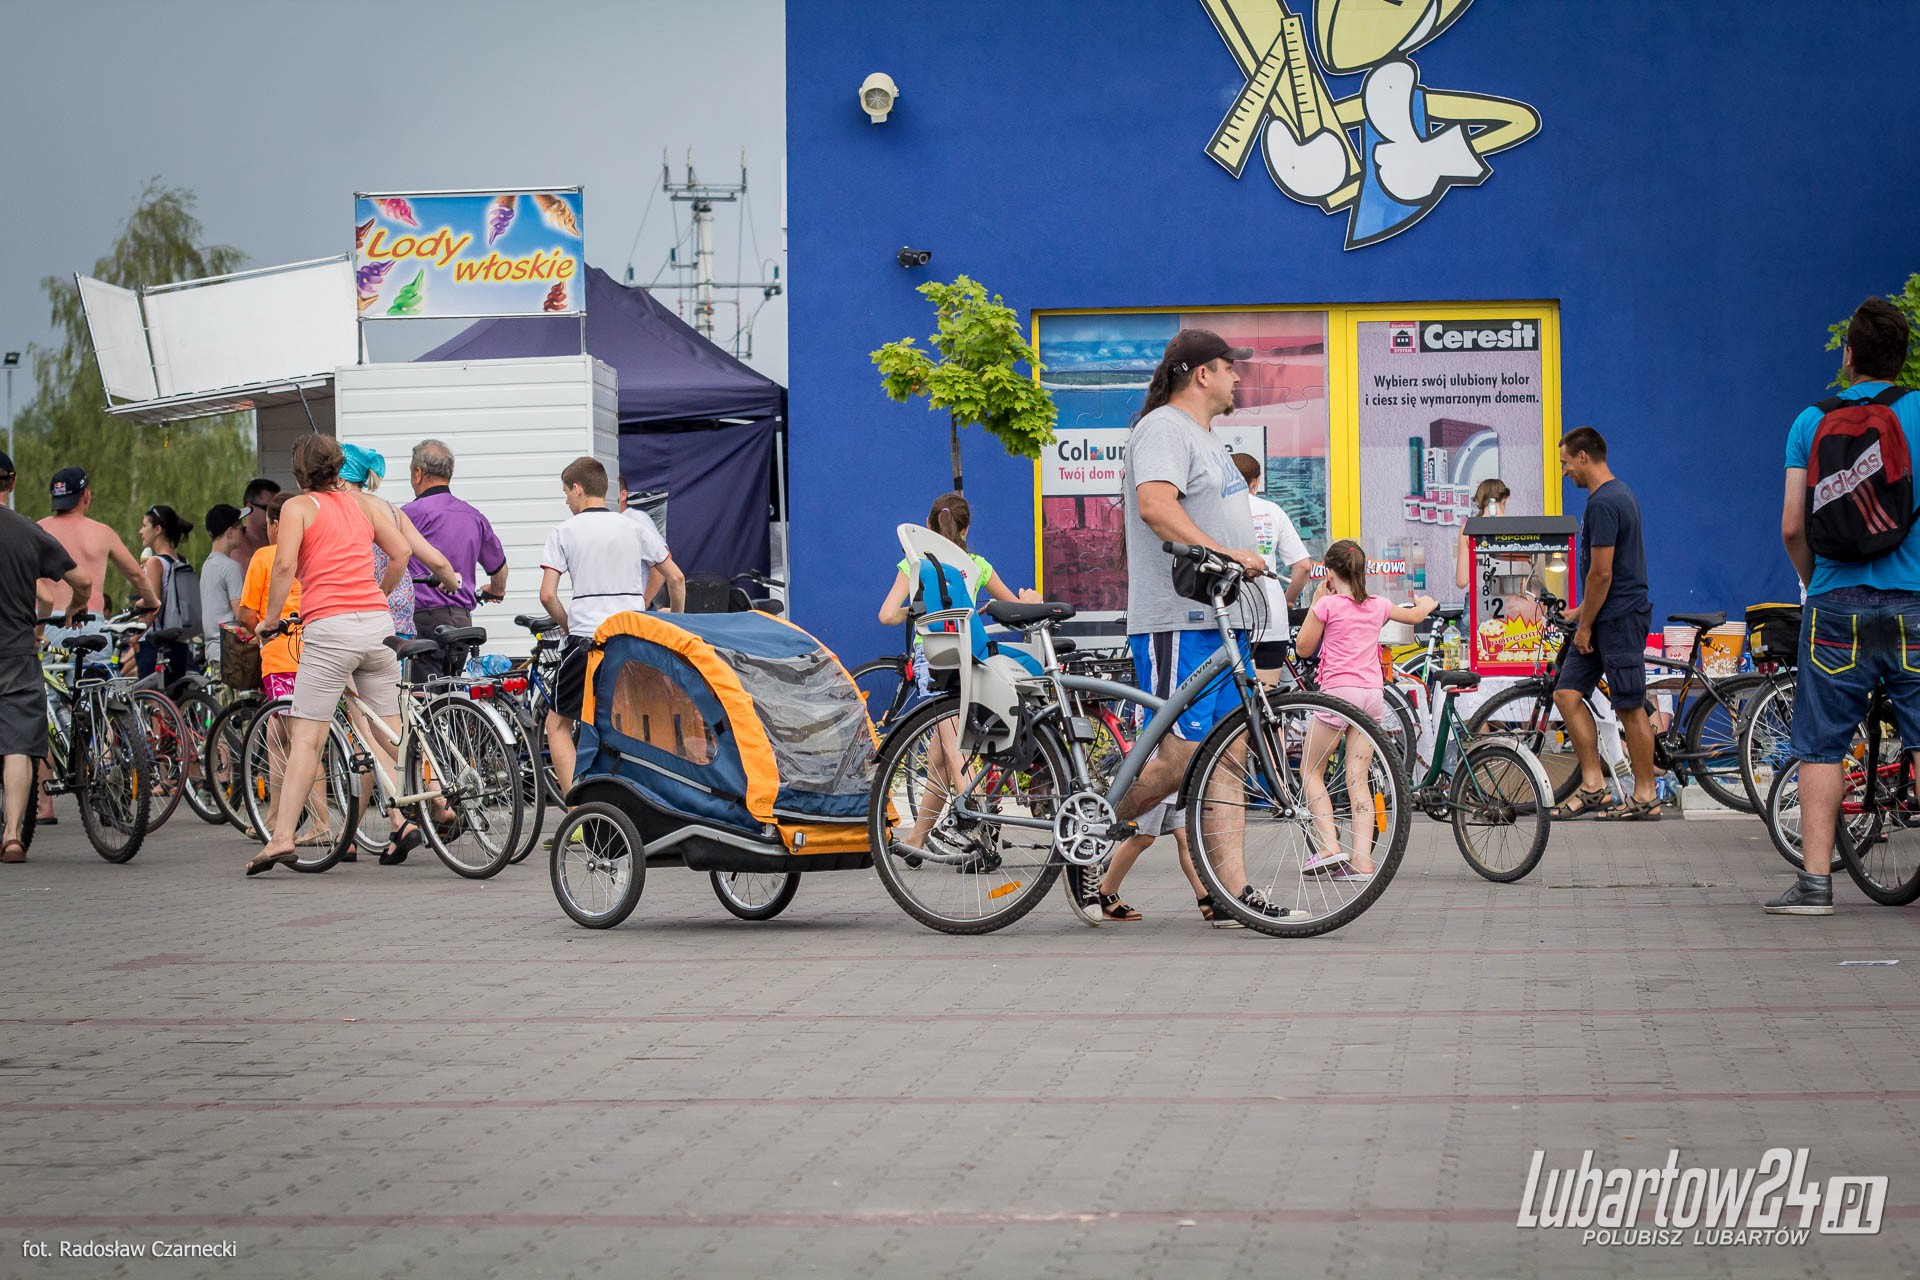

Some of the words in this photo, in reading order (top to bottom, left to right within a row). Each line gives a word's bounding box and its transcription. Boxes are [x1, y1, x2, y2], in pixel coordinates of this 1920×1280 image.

[367, 229, 471, 267] Lody
[455, 250, 575, 282] włoskie
[1424, 321, 1536, 350] Ceresit
[1374, 374, 1418, 390] Wybierz
[1421, 374, 1446, 389] swój
[1450, 372, 1498, 389] ulubiony
[1501, 371, 1530, 385] kolor
[1365, 393, 1369, 406] i
[1372, 393, 1398, 406] ciesz
[1401, 392, 1417, 408] się
[1420, 394, 1491, 408] wymarzonym
[1495, 390, 1540, 404] domem.
[1058, 466, 1085, 483] Twój
[1089, 465, 1115, 479] dom
[1820, 453, 1880, 501] adidas
